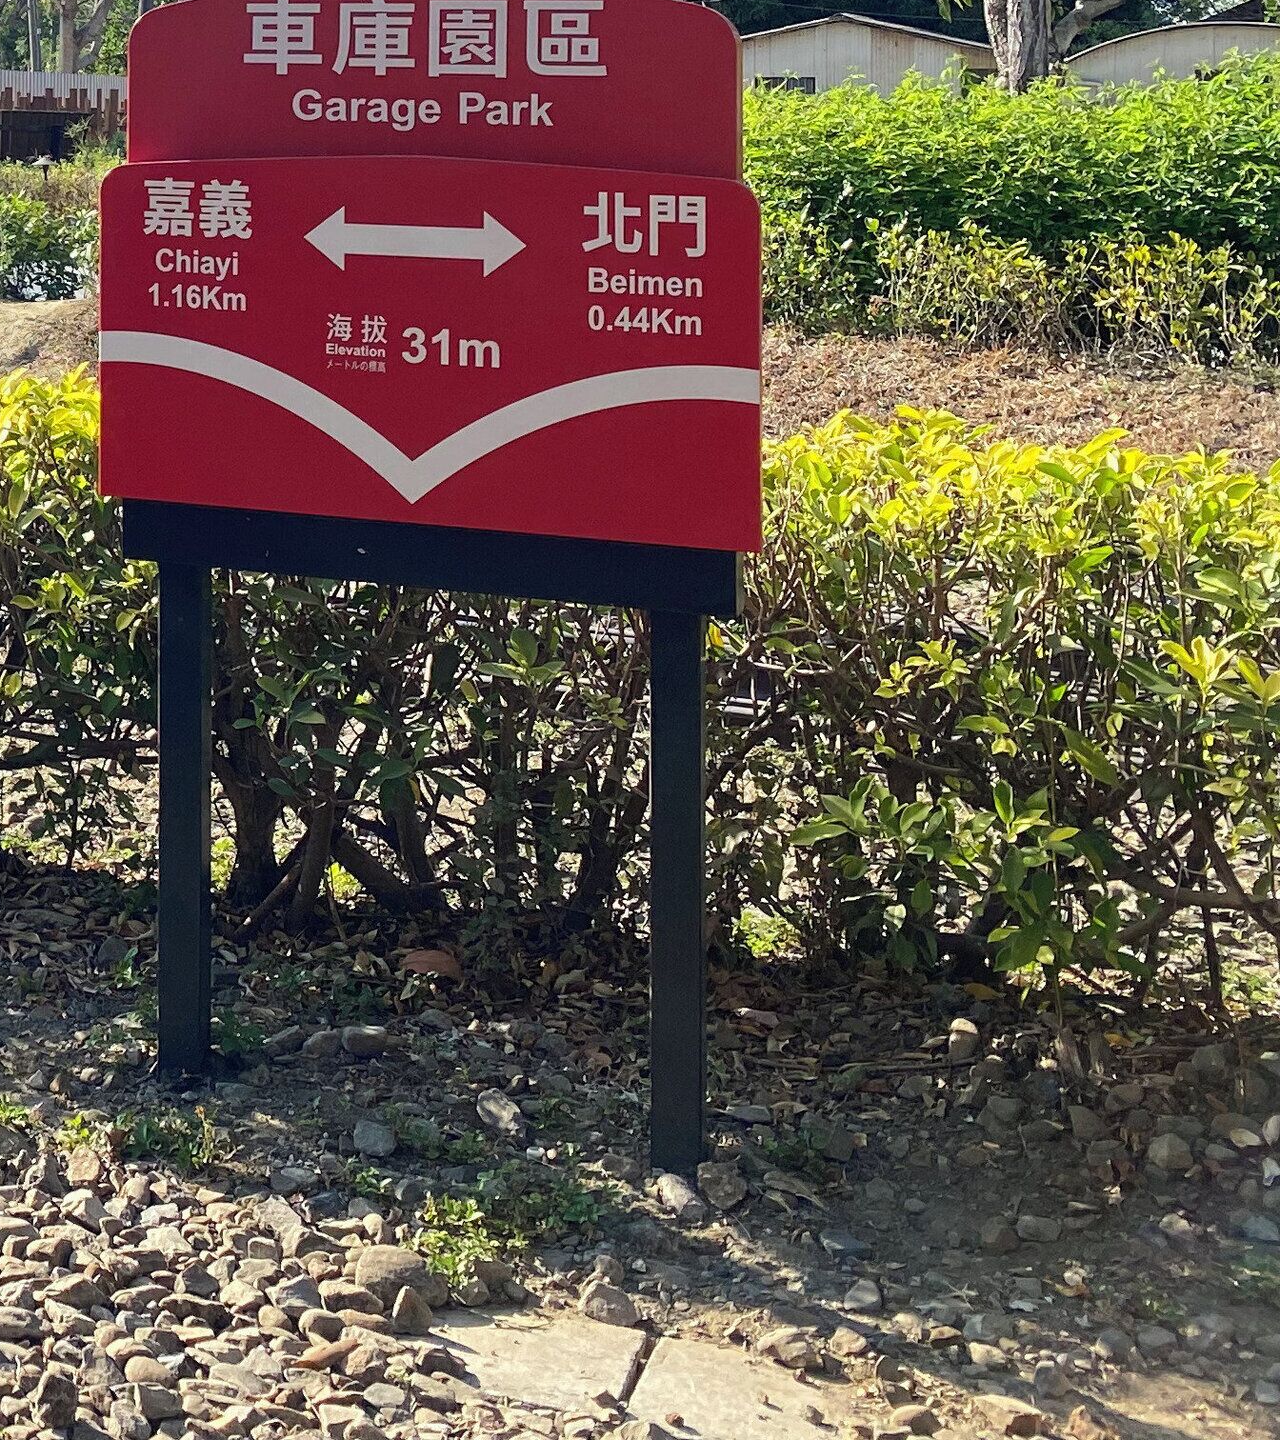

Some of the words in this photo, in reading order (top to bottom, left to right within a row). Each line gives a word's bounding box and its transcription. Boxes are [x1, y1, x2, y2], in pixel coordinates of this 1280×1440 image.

[292, 88, 441, 131] Garage
[458, 92, 554, 127] Park
[143, 177, 253, 240] 嘉義
[581, 191, 707, 258] 北門
[155, 248, 239, 281] Chiayi
[148, 283, 247, 312] 1.16Km
[588, 267, 703, 298] Beimen
[326, 313, 388, 344] 海拔
[588, 305, 702, 336] 0.44Km
[325, 343, 386, 358] Elevation
[401, 327, 501, 369] 31m
